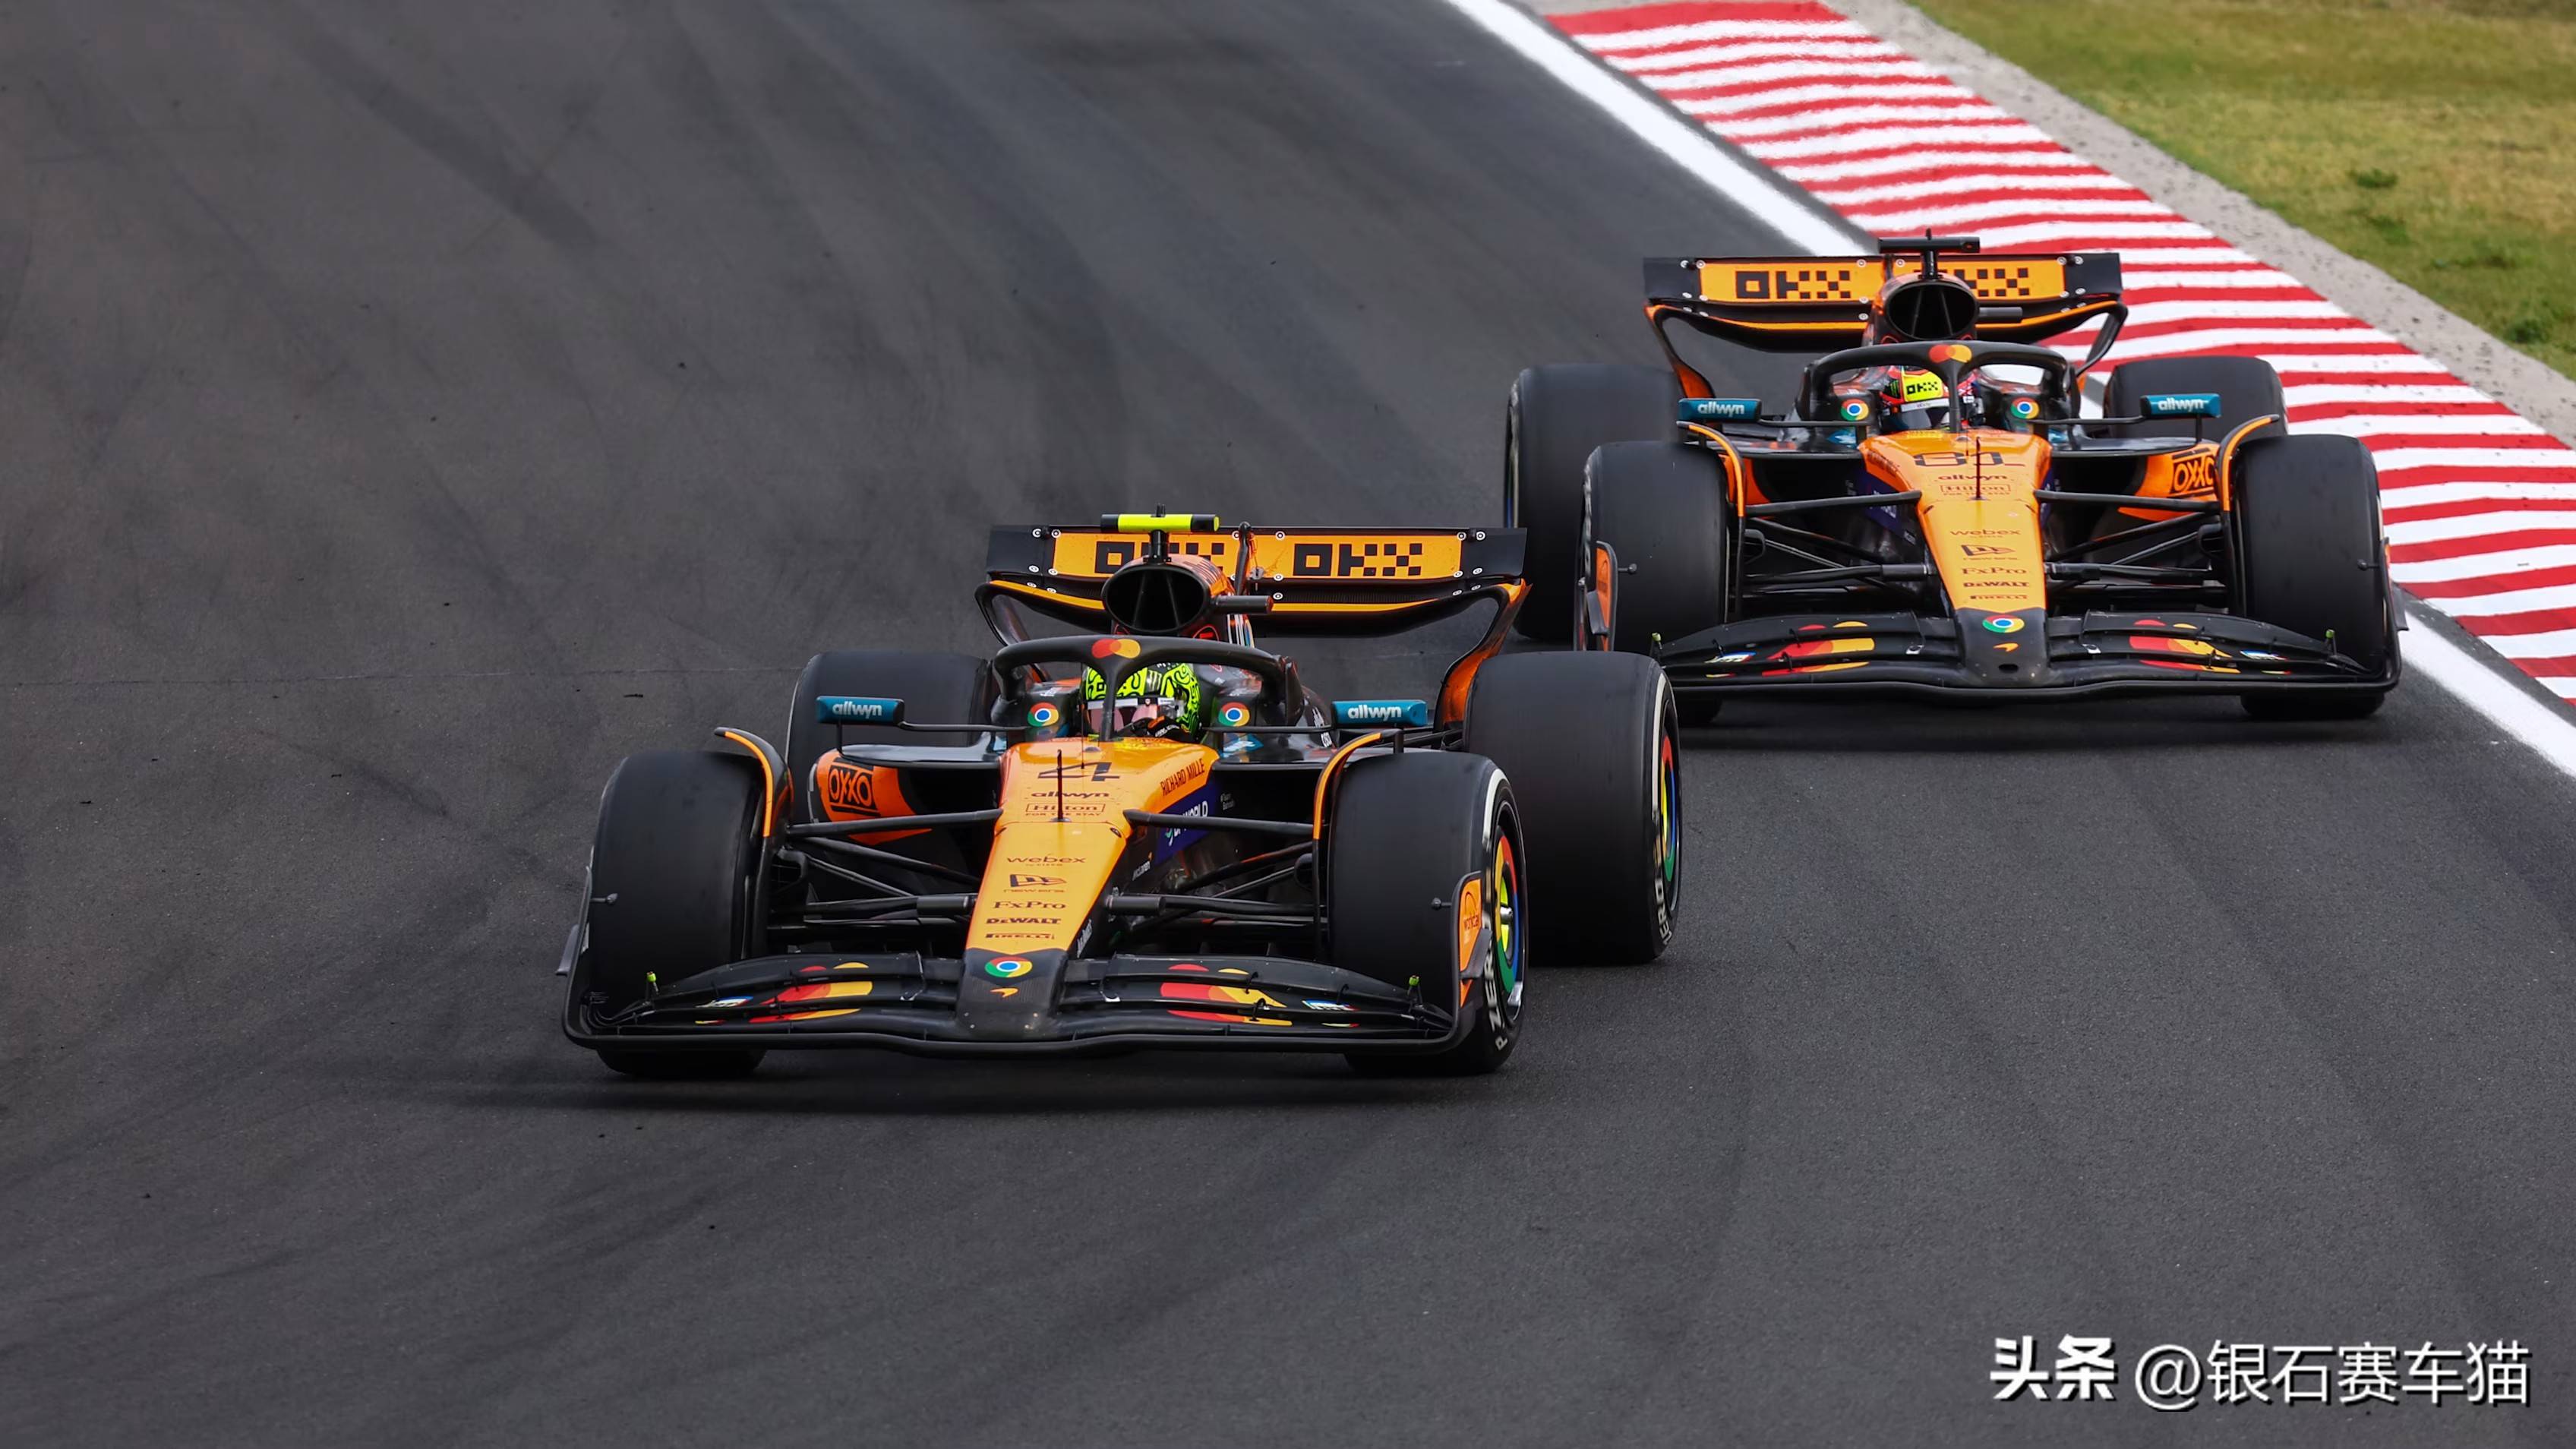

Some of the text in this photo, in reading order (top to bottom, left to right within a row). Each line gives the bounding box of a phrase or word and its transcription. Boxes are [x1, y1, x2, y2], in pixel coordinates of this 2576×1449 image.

[1735, 269, 1851, 299] OKX
[1906, 381, 1938, 394] OKX
[1697, 401, 1745, 417] allwyn
[2158, 396, 2205, 412] allwyn
[2173, 457, 2215, 492] OXXO
[1293, 542, 1422, 576] OKX
[832, 701, 882, 719] allwyn
[1347, 703, 1403, 721] allwyn
[1037, 762, 1120, 781] 4
[1160, 758, 1205, 797] RICHARD MILLE
[829, 768, 873, 807] OXXO
[993, 901, 1066, 909] FxPro
